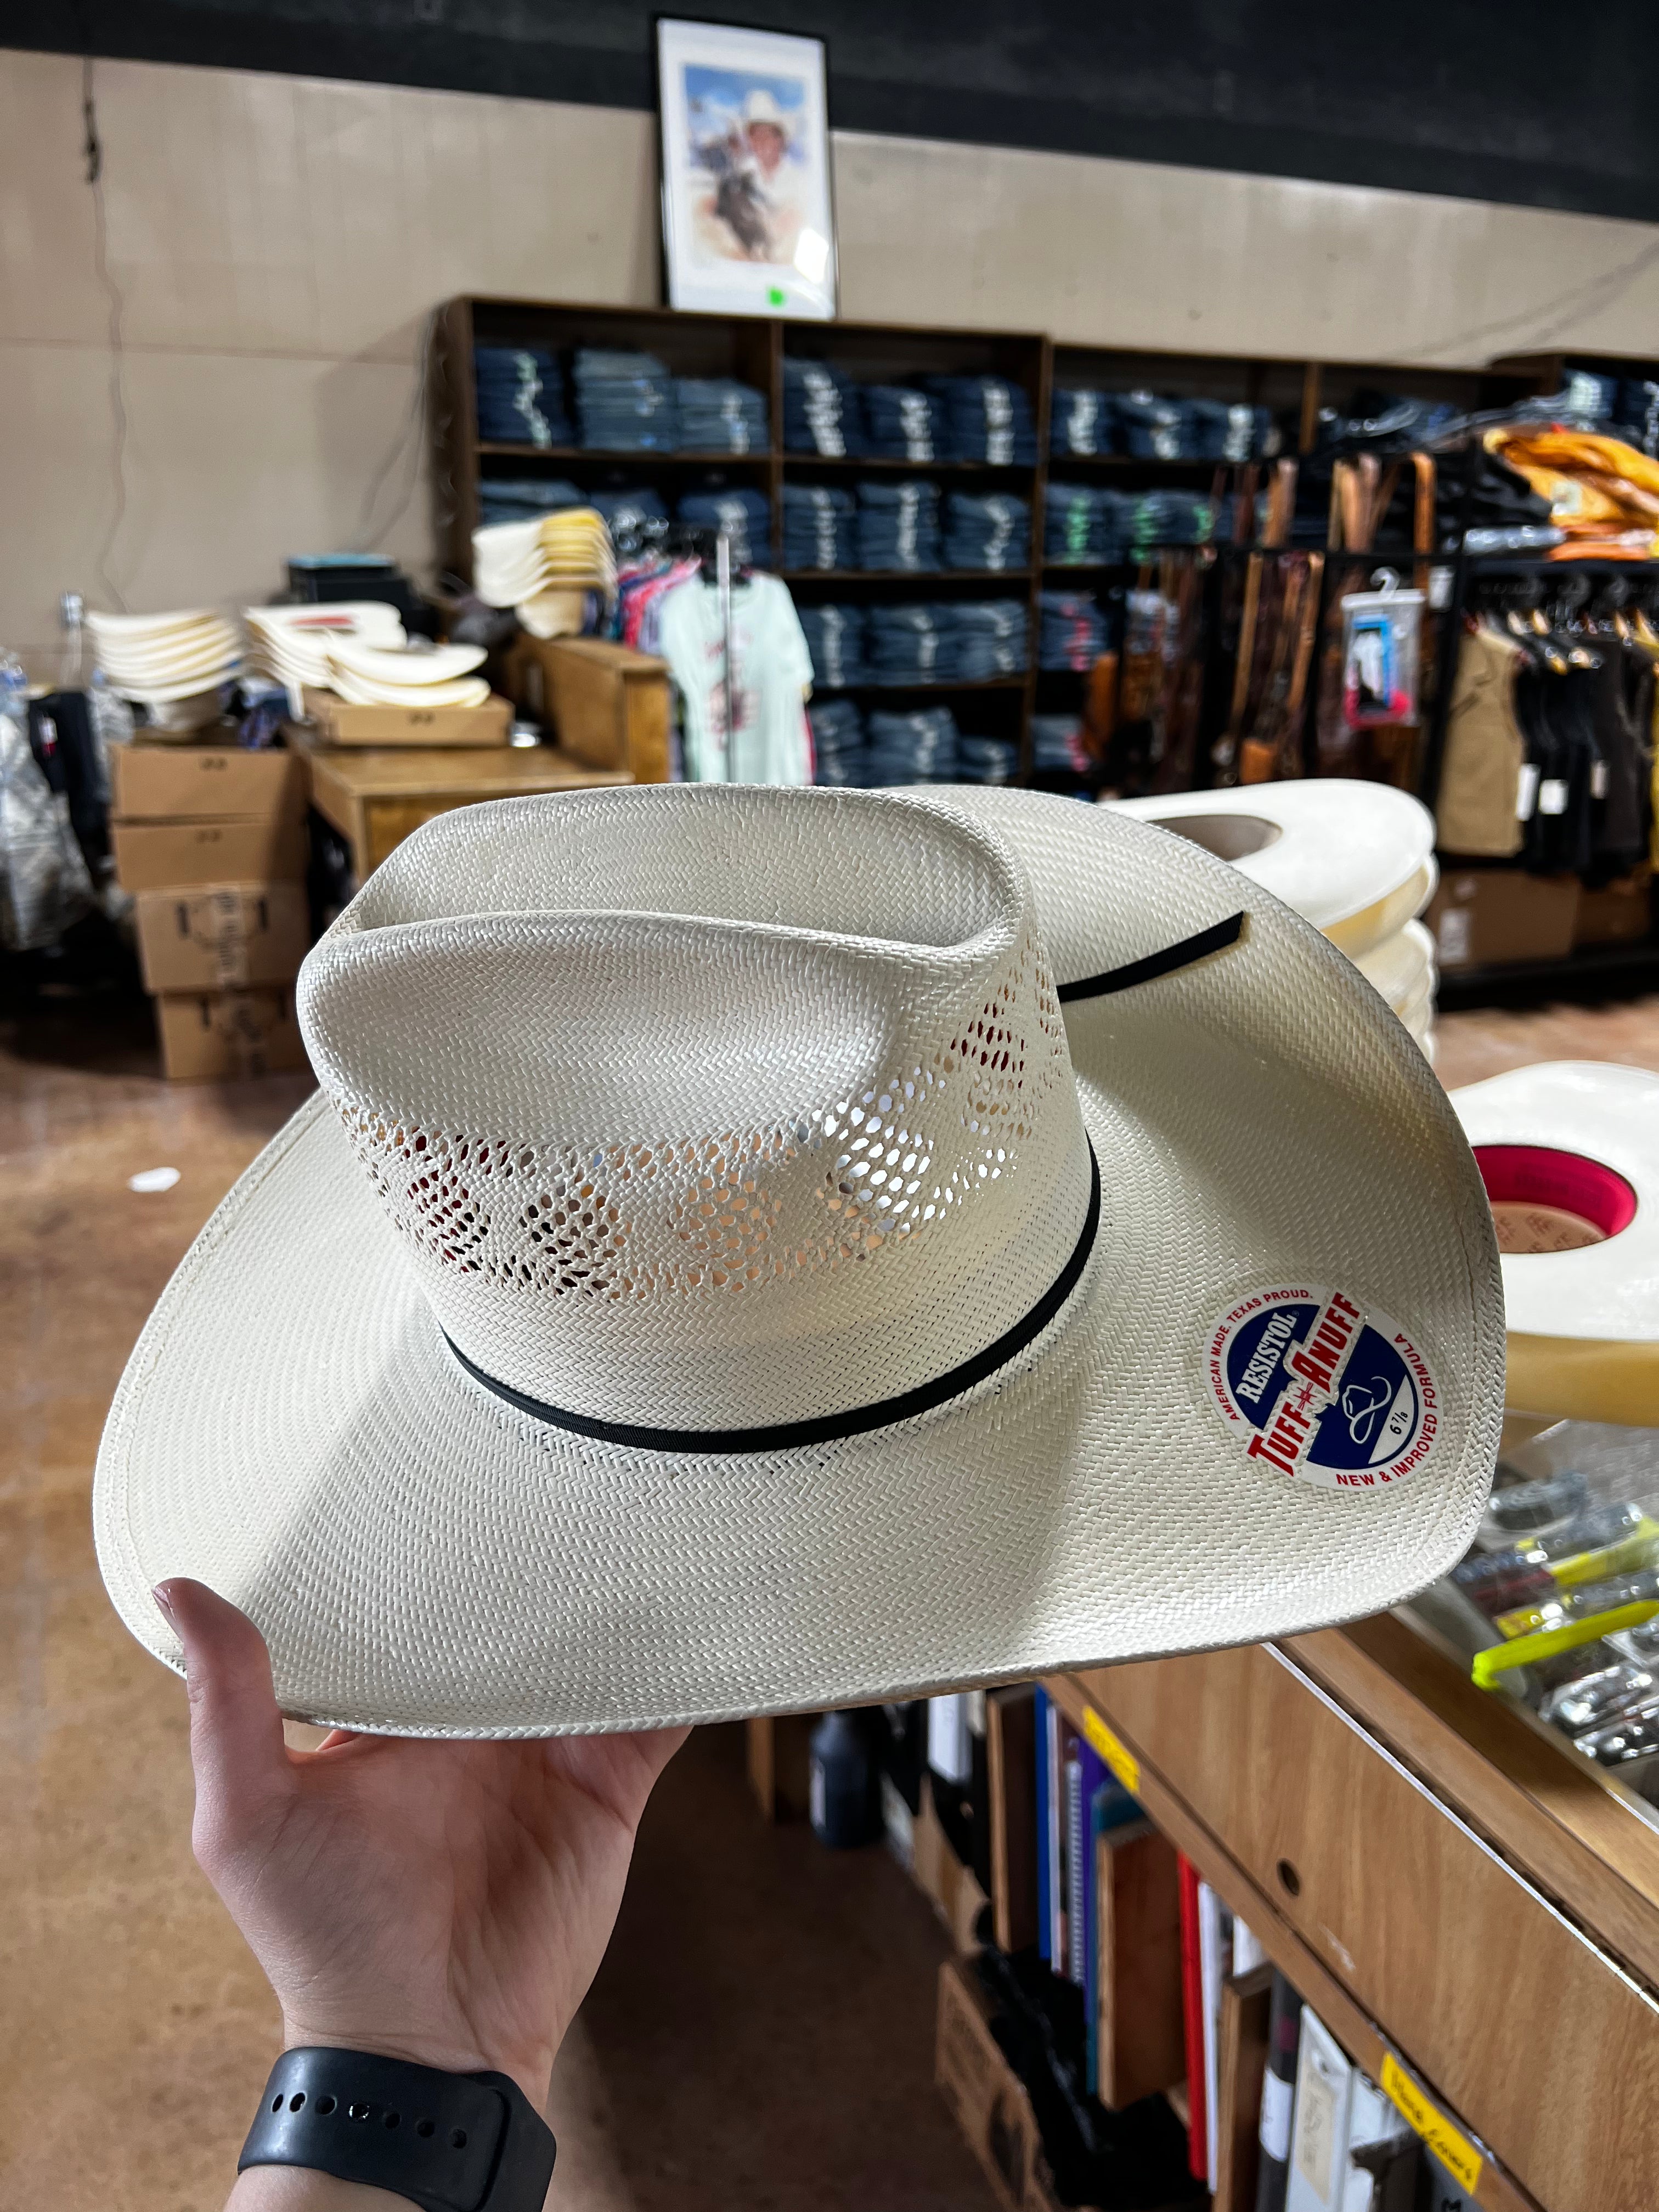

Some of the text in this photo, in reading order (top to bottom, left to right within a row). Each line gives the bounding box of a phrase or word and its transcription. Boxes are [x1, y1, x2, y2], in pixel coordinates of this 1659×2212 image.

[1210, 1289, 1313, 1421] AMERICAN MADE. TEXAS PROUD.
[1235, 1312, 1297, 1404] RESISTOL
[1247, 1291, 1361, 1477] TUFF ANUFF
[1336, 1333, 1438, 1486] NEW & IMPROVED FORMULA
